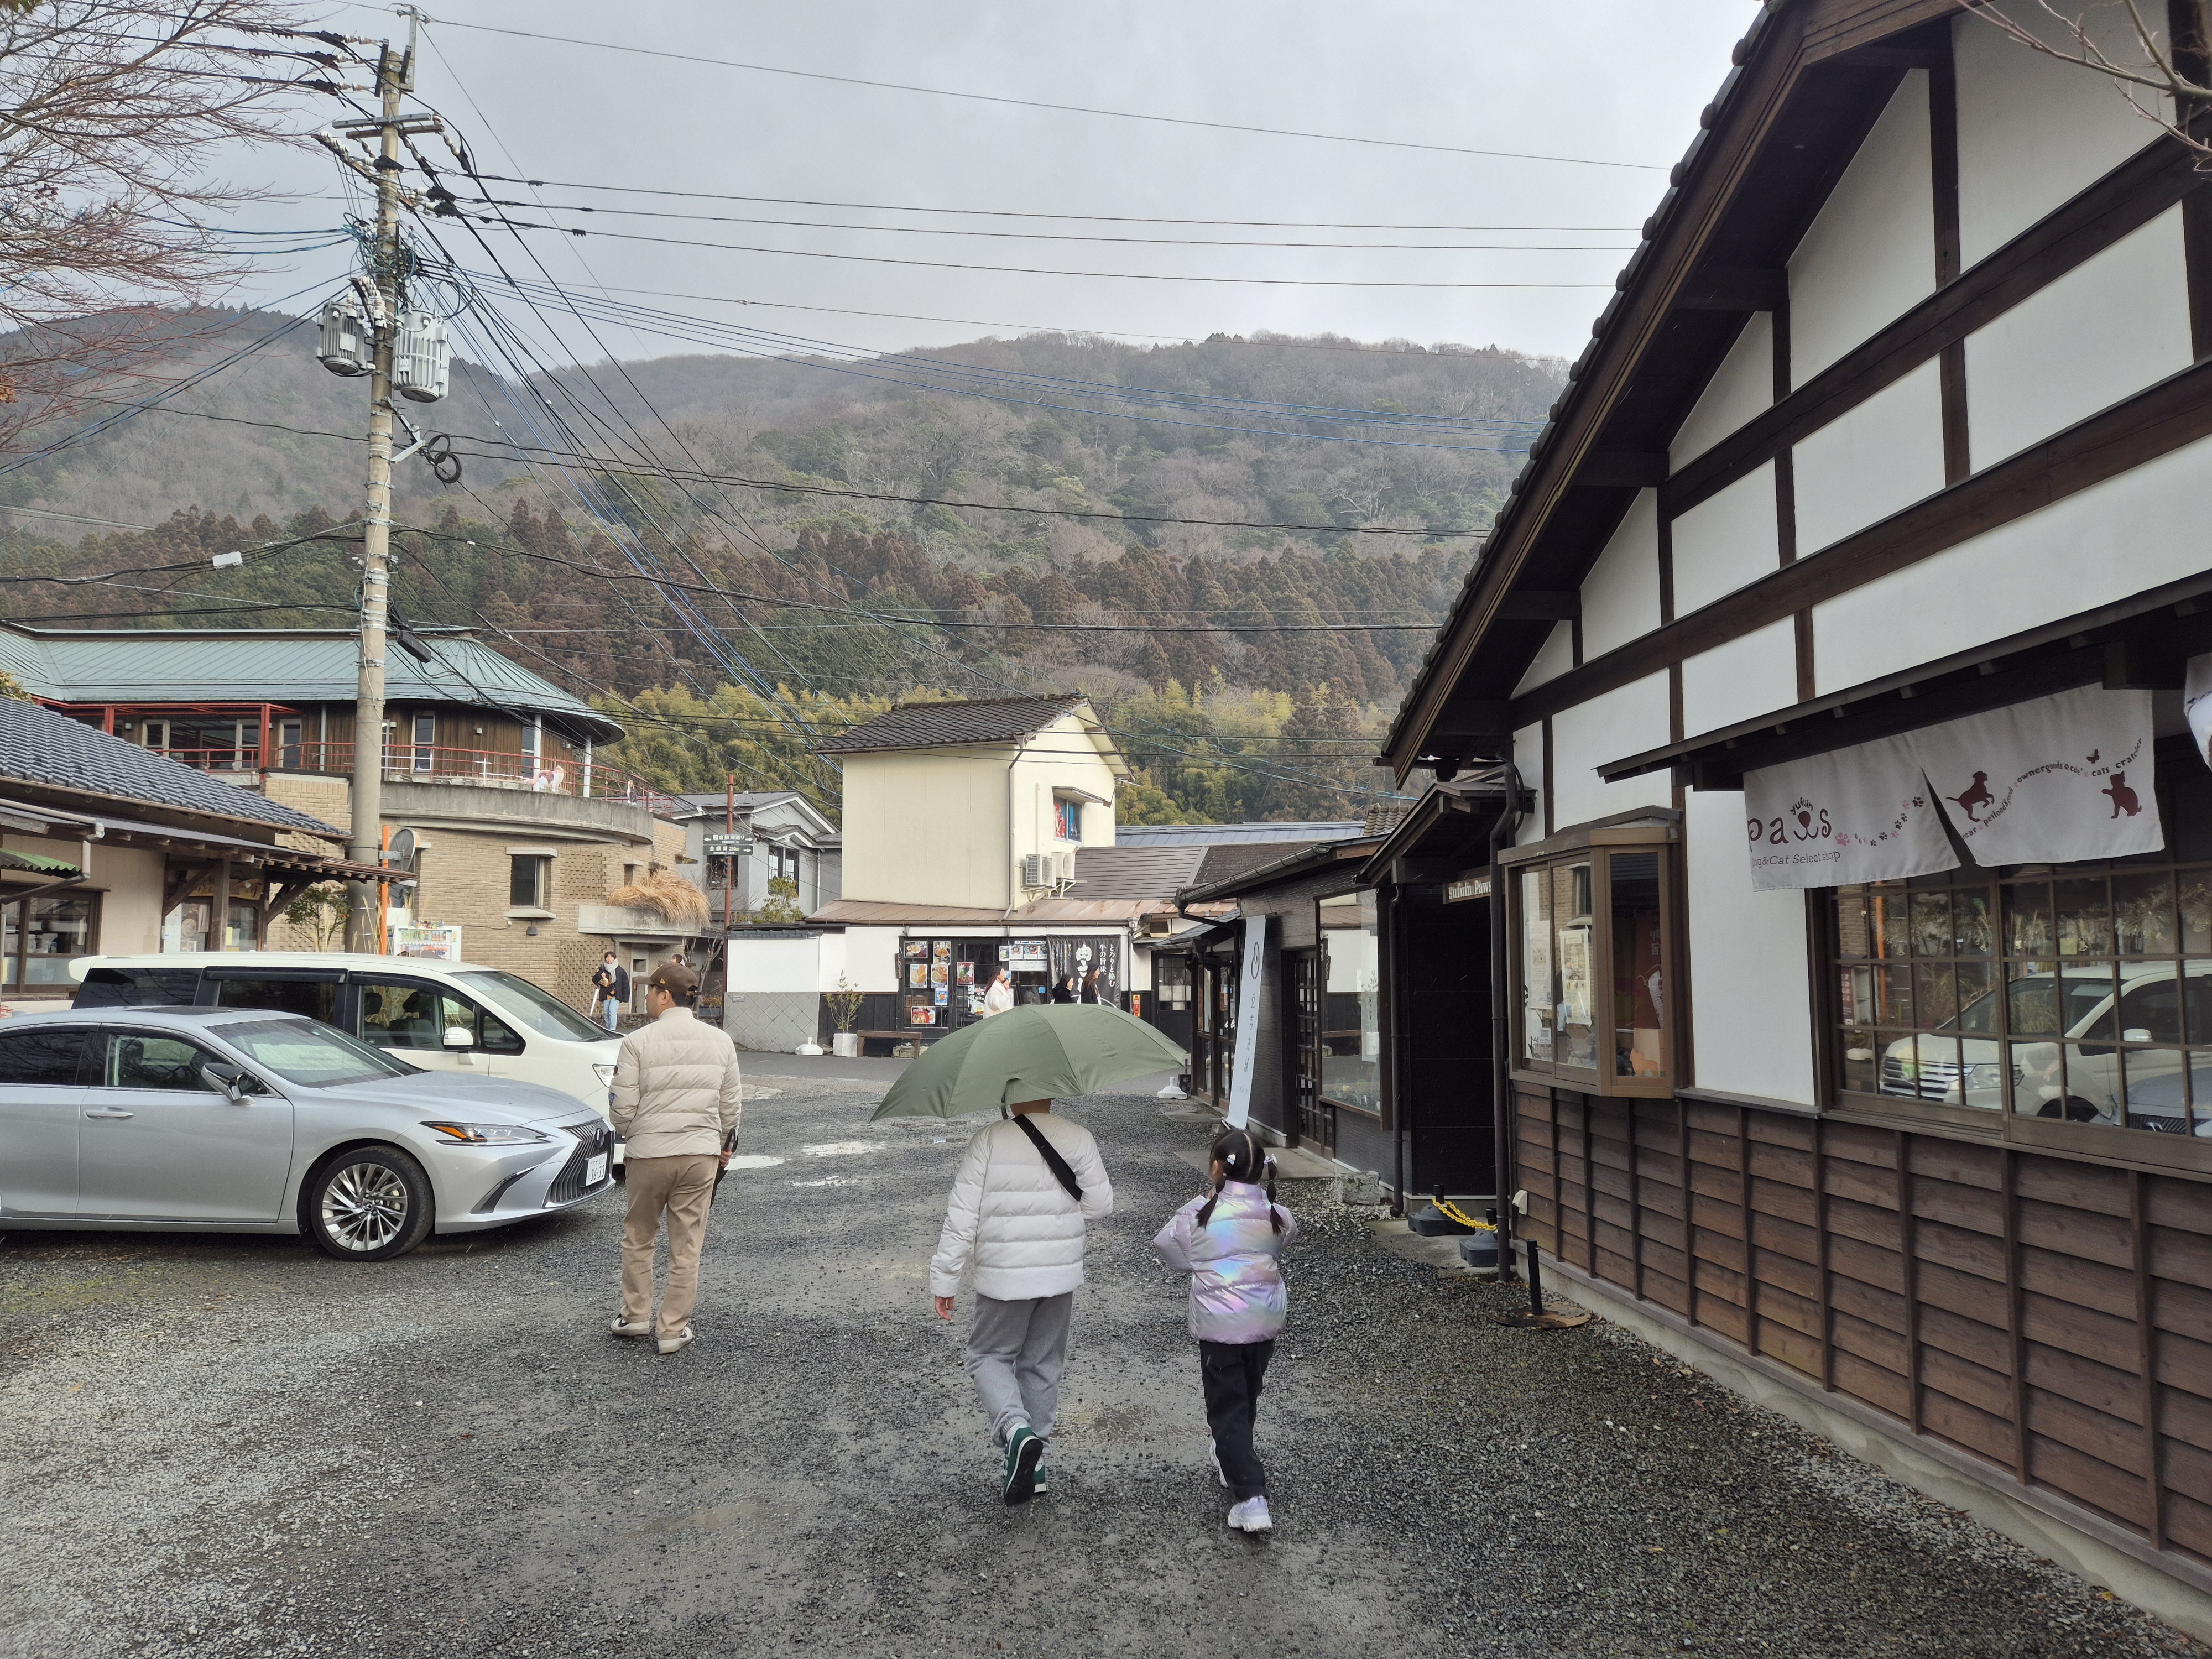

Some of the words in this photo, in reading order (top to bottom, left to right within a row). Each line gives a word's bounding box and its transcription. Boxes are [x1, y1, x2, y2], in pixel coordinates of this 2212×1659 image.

[1790, 797, 1813, 815] yufuin
[1963, 827, 1976, 838] ear
[2091, 766, 2110, 776] cats
[1474, 880, 1491, 894] Paws
